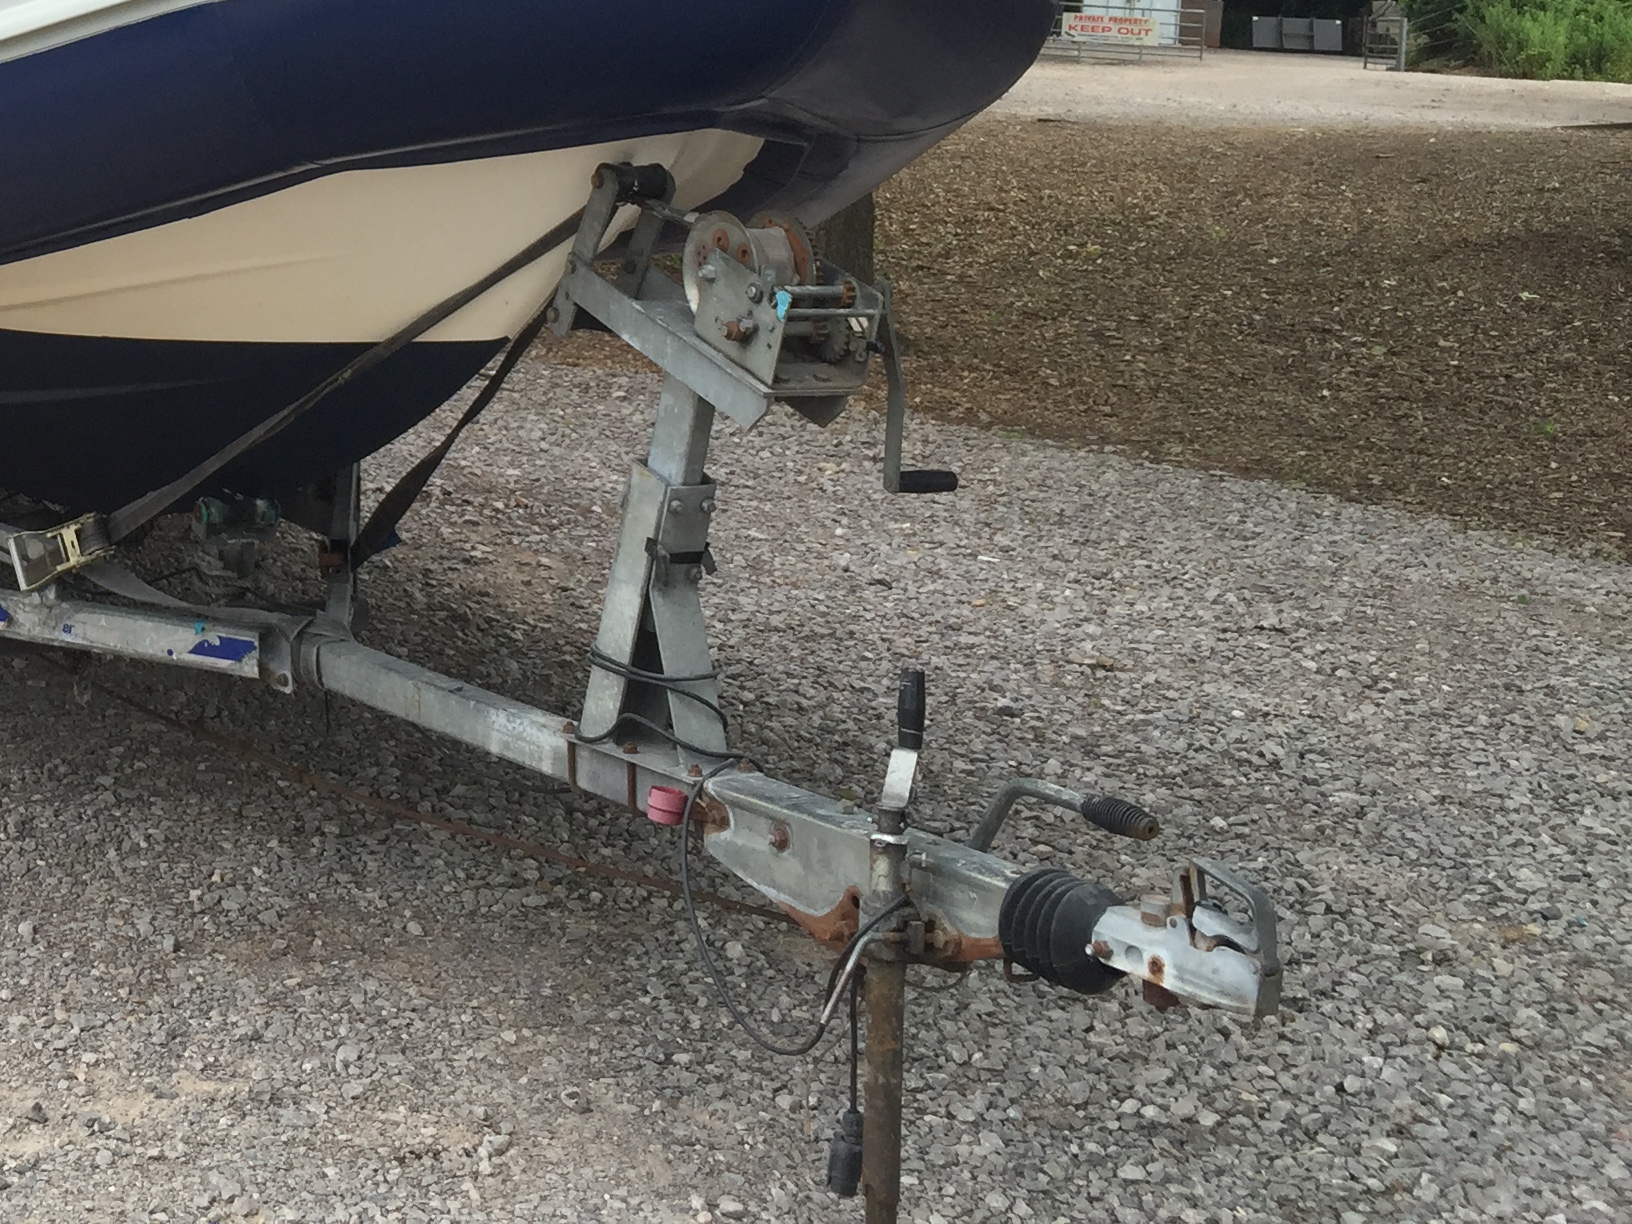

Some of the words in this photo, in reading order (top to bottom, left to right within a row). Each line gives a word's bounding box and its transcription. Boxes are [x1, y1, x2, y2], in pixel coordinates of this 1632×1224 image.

[1108, 16, 1148, 25] PROPERTY
[1068, 23, 1112, 33] KEEP
[1117, 26, 1152, 36] OUT
